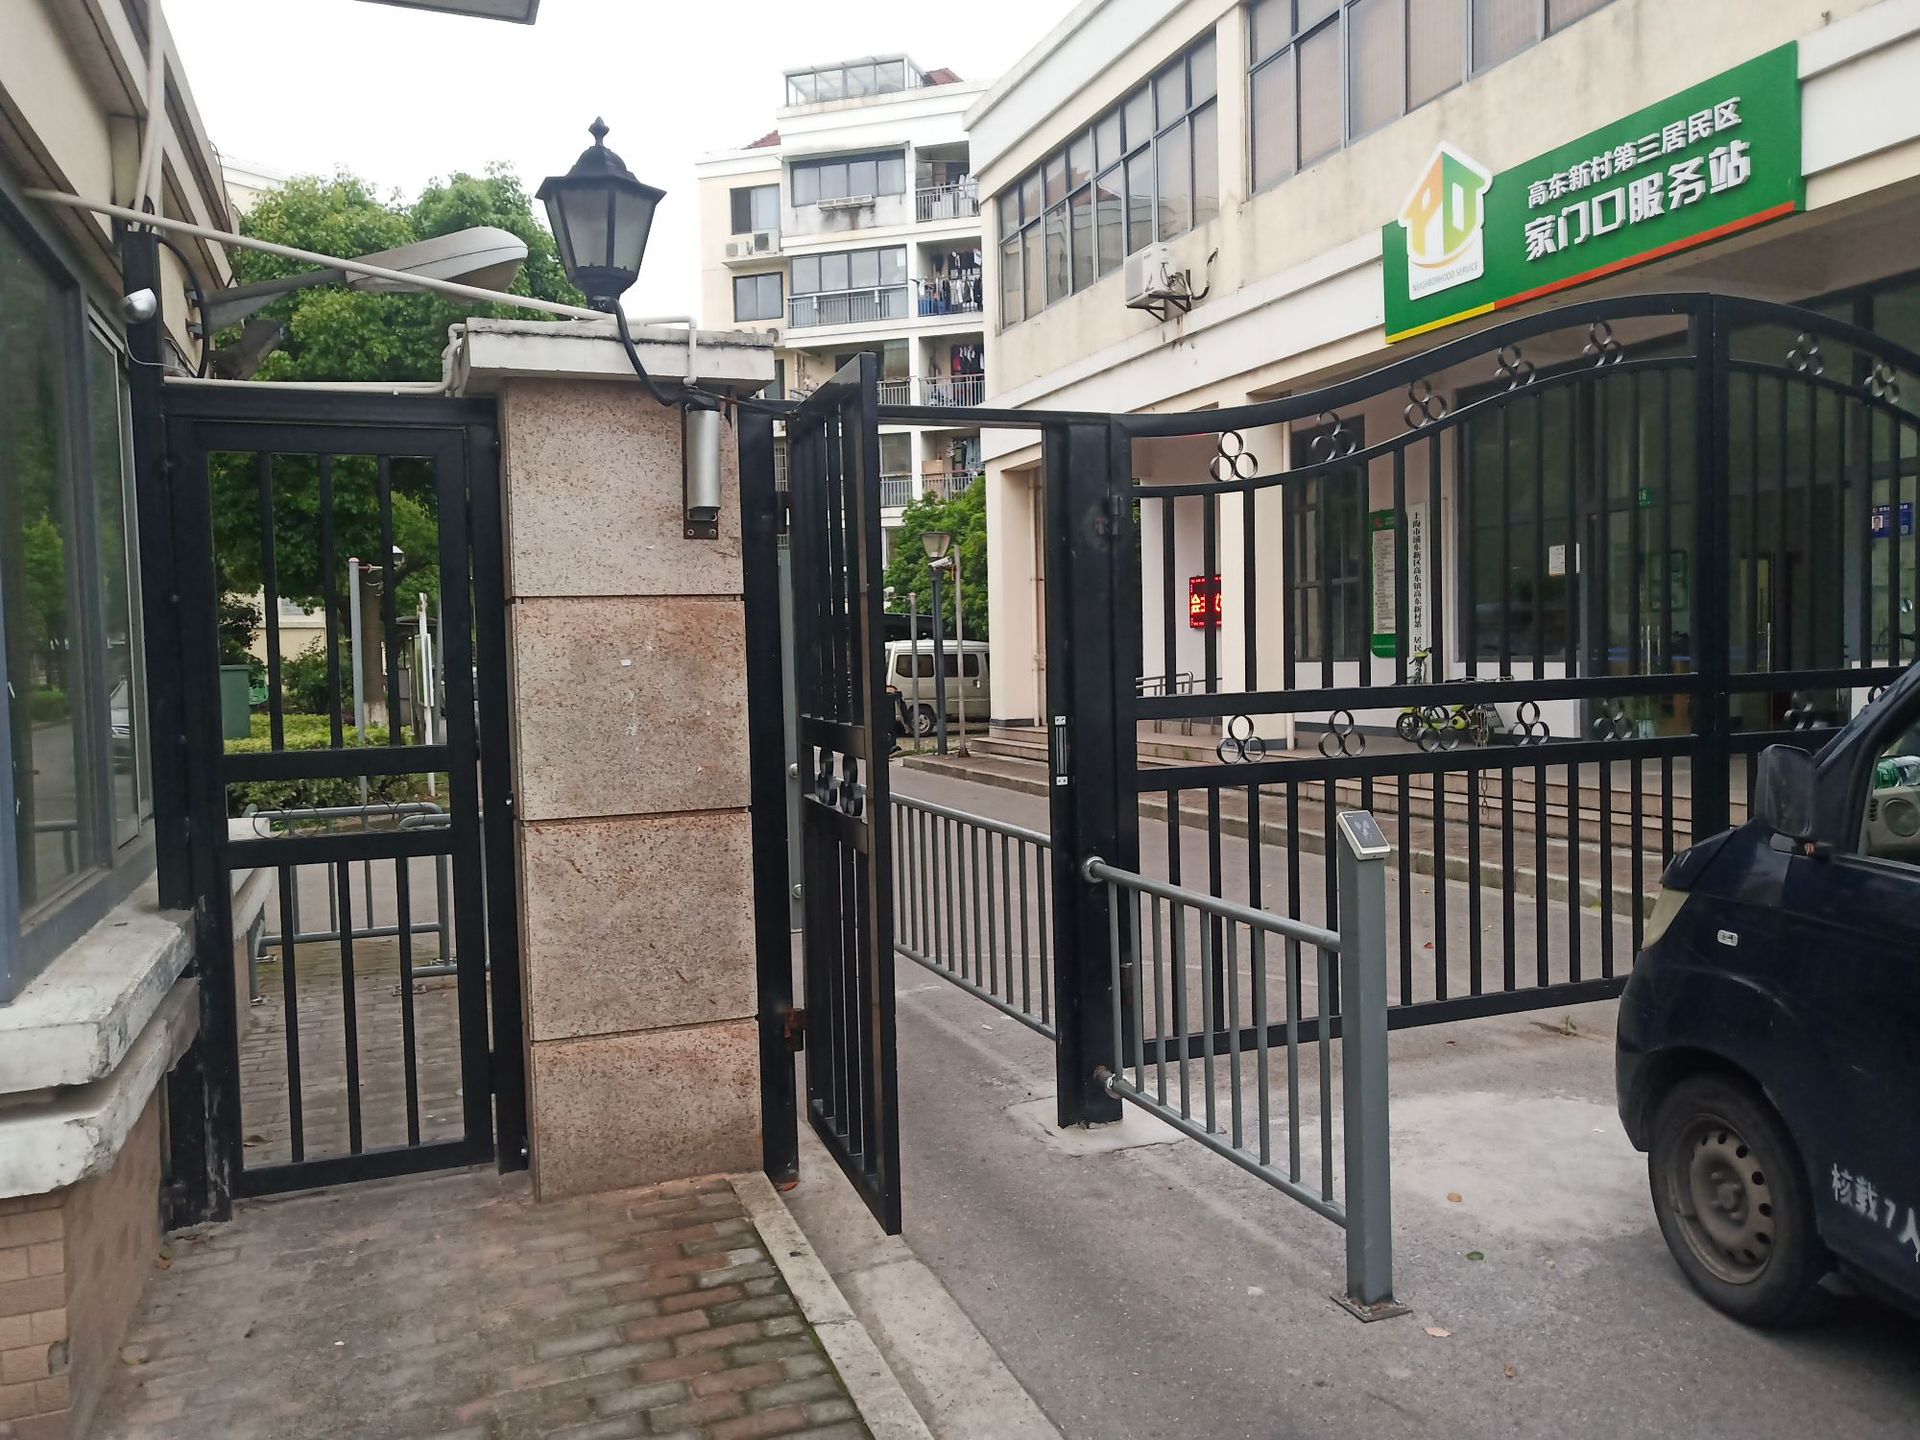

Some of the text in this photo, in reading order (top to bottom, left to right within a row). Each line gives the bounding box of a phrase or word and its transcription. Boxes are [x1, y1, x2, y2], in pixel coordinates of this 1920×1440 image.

[1524, 139, 1752, 262] 家门口服务站
[1527, 96, 1743, 209] 高东新村第三居民区
